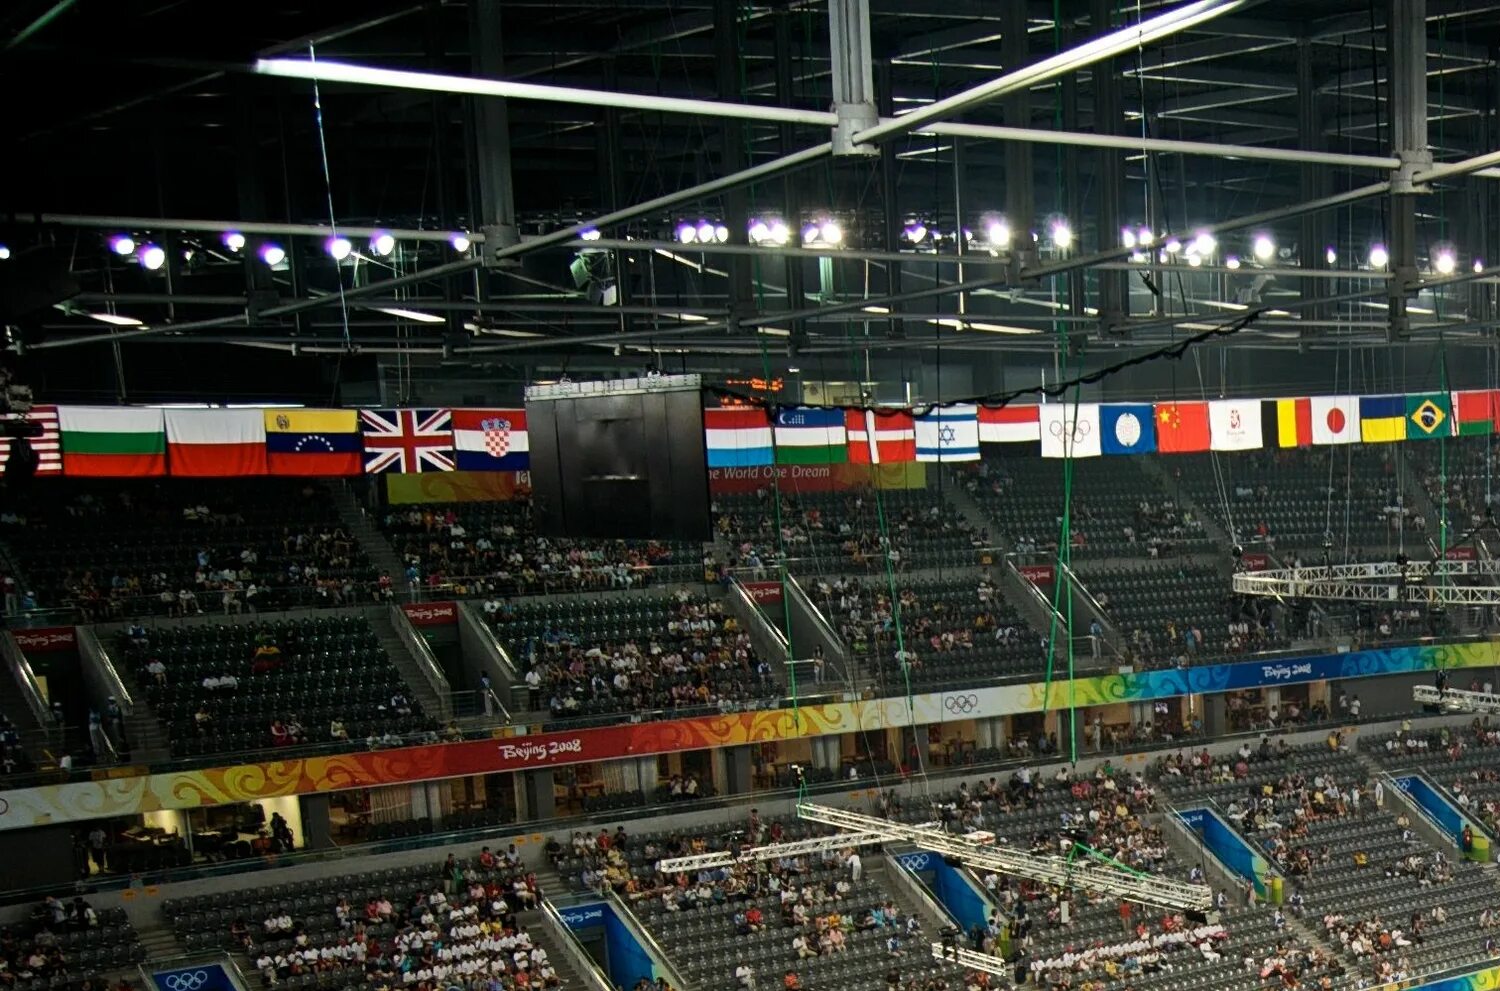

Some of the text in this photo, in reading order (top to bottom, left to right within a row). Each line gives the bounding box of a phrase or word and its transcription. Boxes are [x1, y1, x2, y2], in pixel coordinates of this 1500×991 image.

[725, 467, 758, 479] World
[792, 465, 830, 478] Dream
[406, 608, 432, 619] Beijing
[15, 634, 49, 646] Beijing
[1262, 662, 1311, 679] Beijing 2008
[499, 739, 582, 760] Beijing 2008
